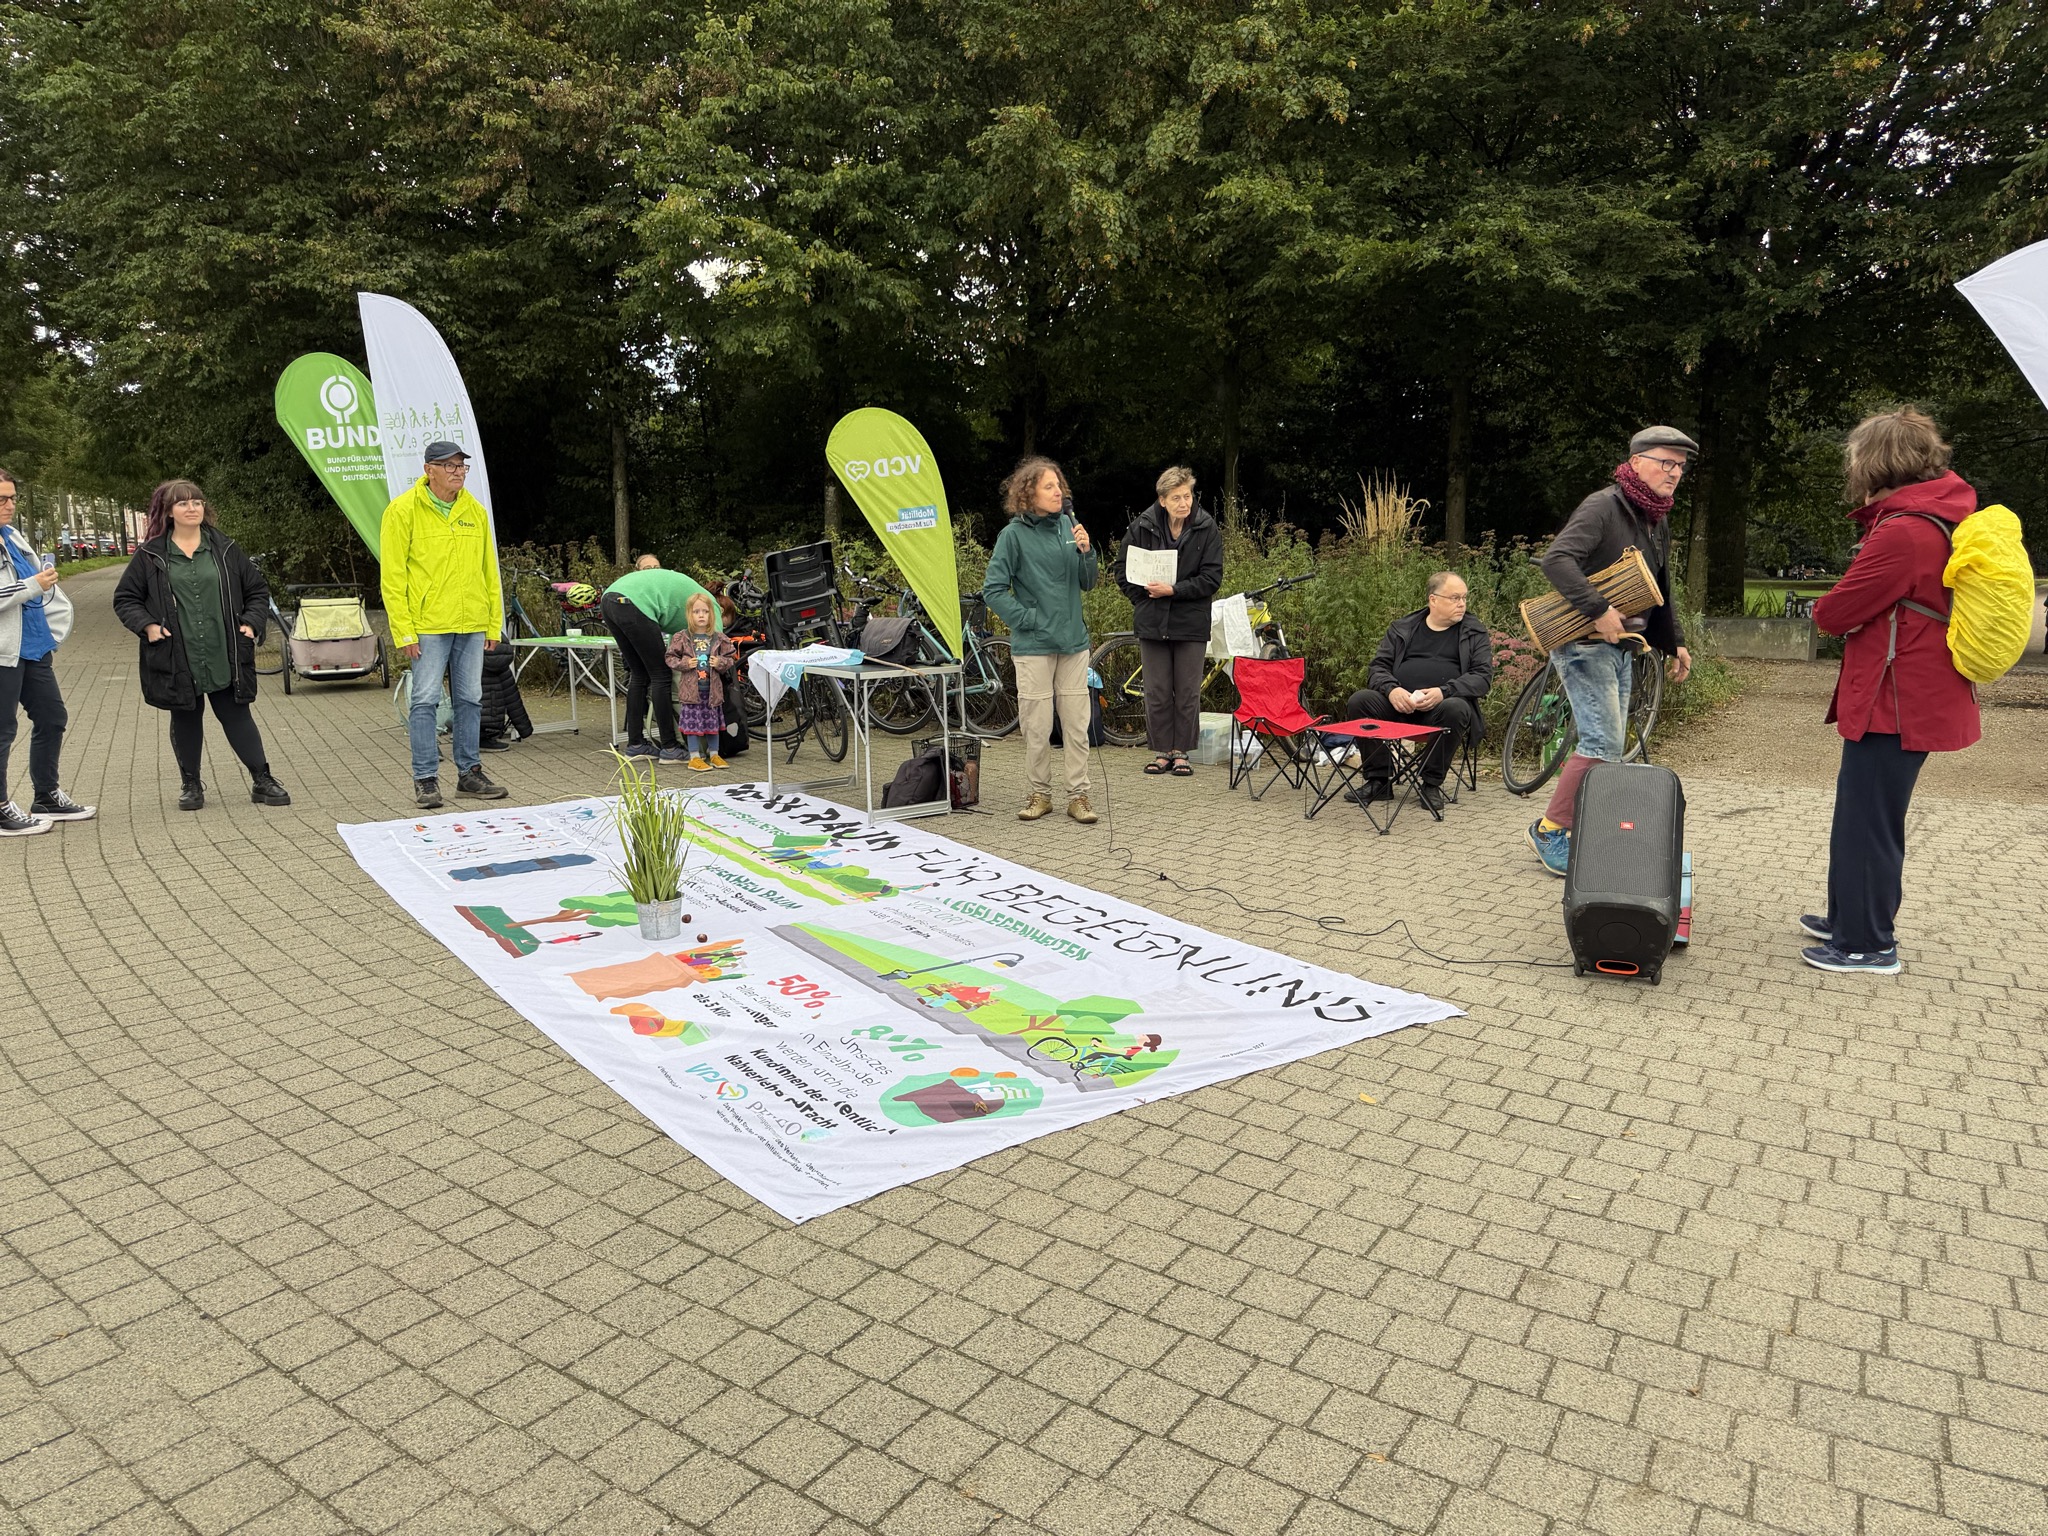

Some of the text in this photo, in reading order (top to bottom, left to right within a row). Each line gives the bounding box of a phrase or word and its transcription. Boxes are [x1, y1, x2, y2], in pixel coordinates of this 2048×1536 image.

[306, 425, 382, 450] BUND
[327, 454, 385, 463] BUND FÜR UMWE
[341, 464, 386, 473] NATURSCHUT
[342, 474, 387, 482] DEUTSCHLAN
[889, 848, 1002, 886] FÜR
[766, 974, 842, 1009] 50%
[692, 993, 710, 1004] als
